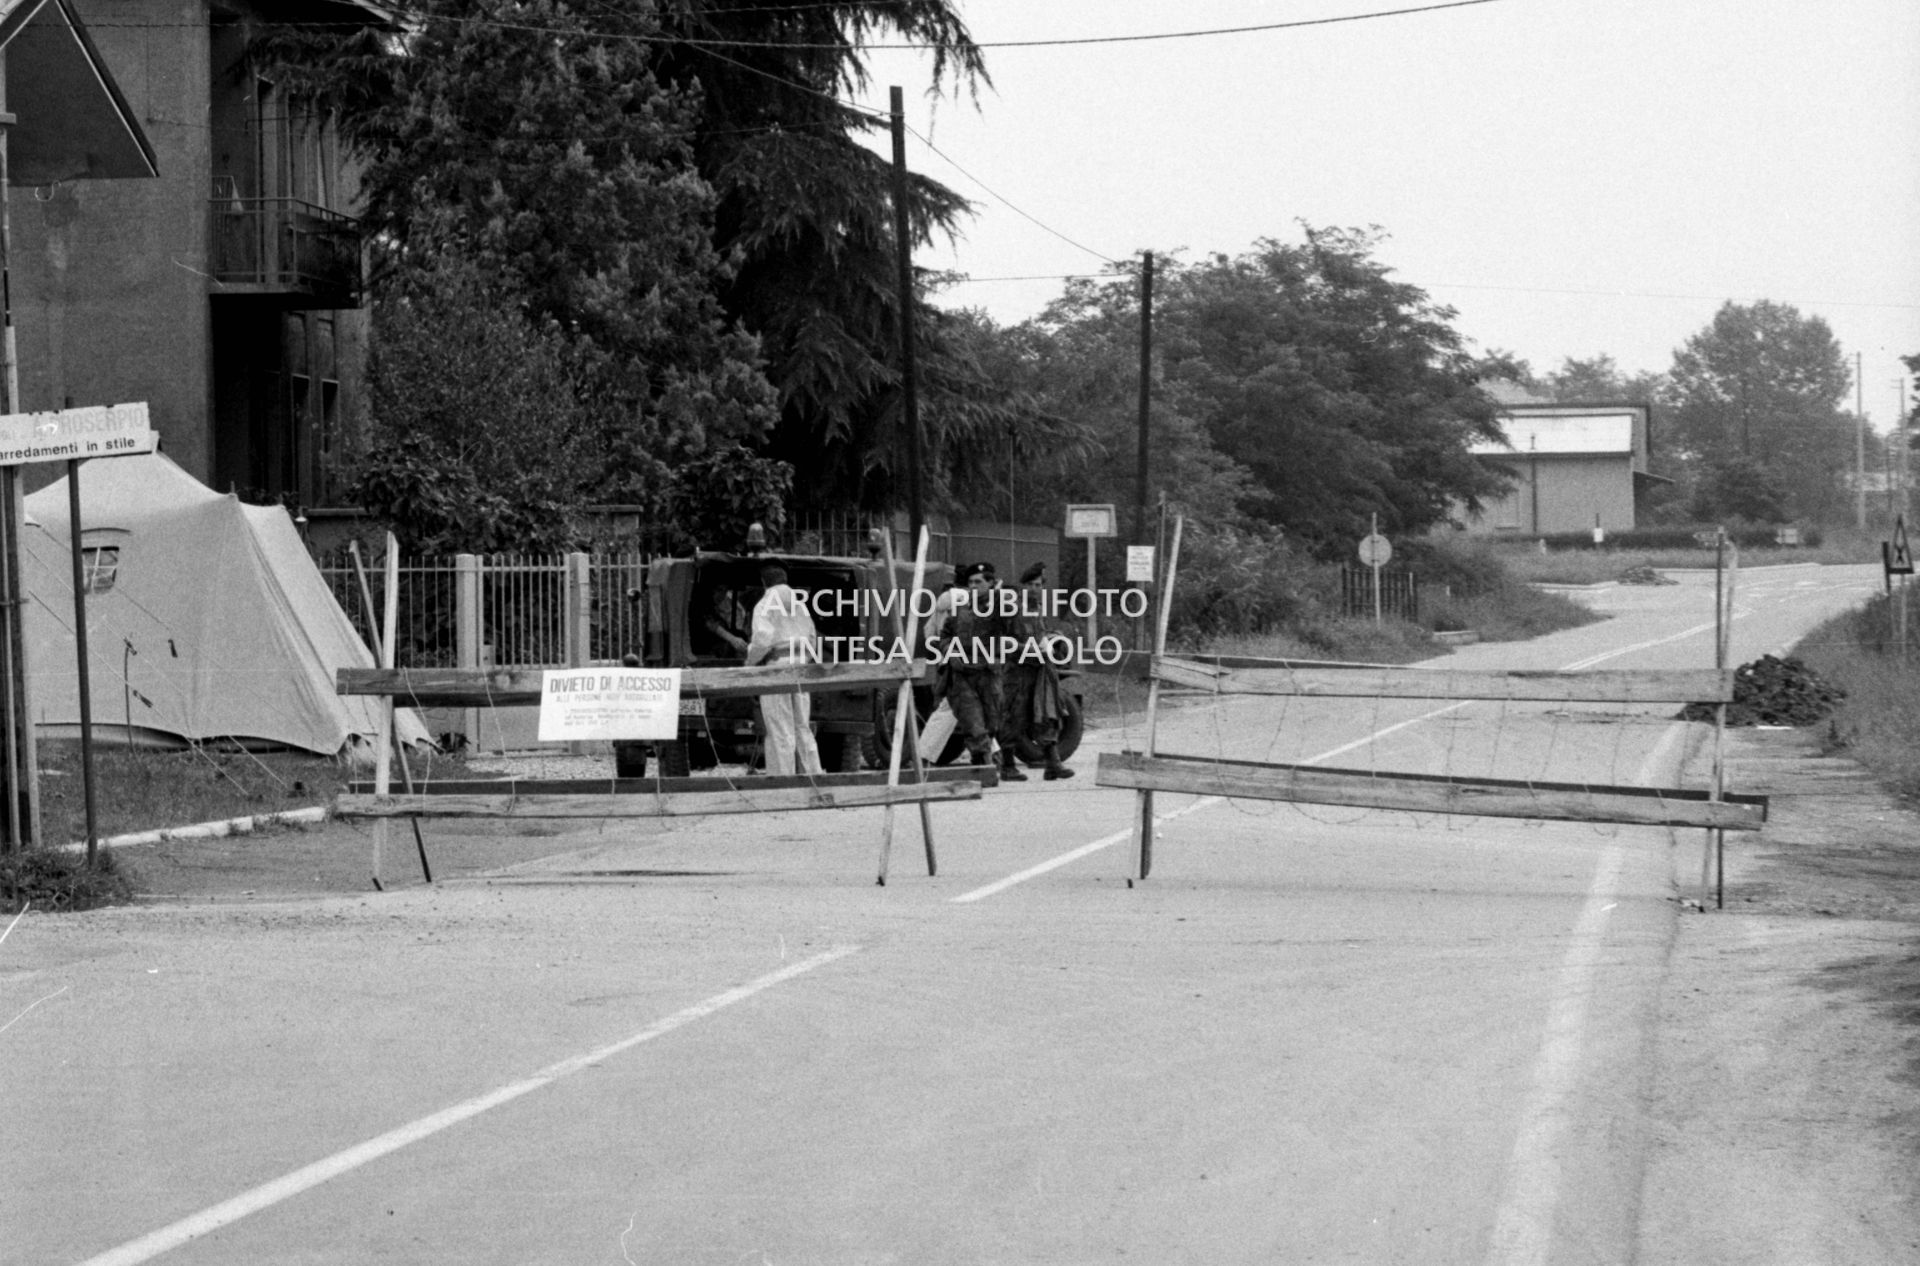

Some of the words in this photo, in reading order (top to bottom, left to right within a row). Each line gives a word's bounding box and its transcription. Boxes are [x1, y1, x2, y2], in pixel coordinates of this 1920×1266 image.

[87, 441, 98, 452] in
[106, 437, 135, 450] stile
[550, 676, 595, 693] DIVIETO
[600, 676, 612, 691] DI
[617, 676, 672, 691] ACCESSO
